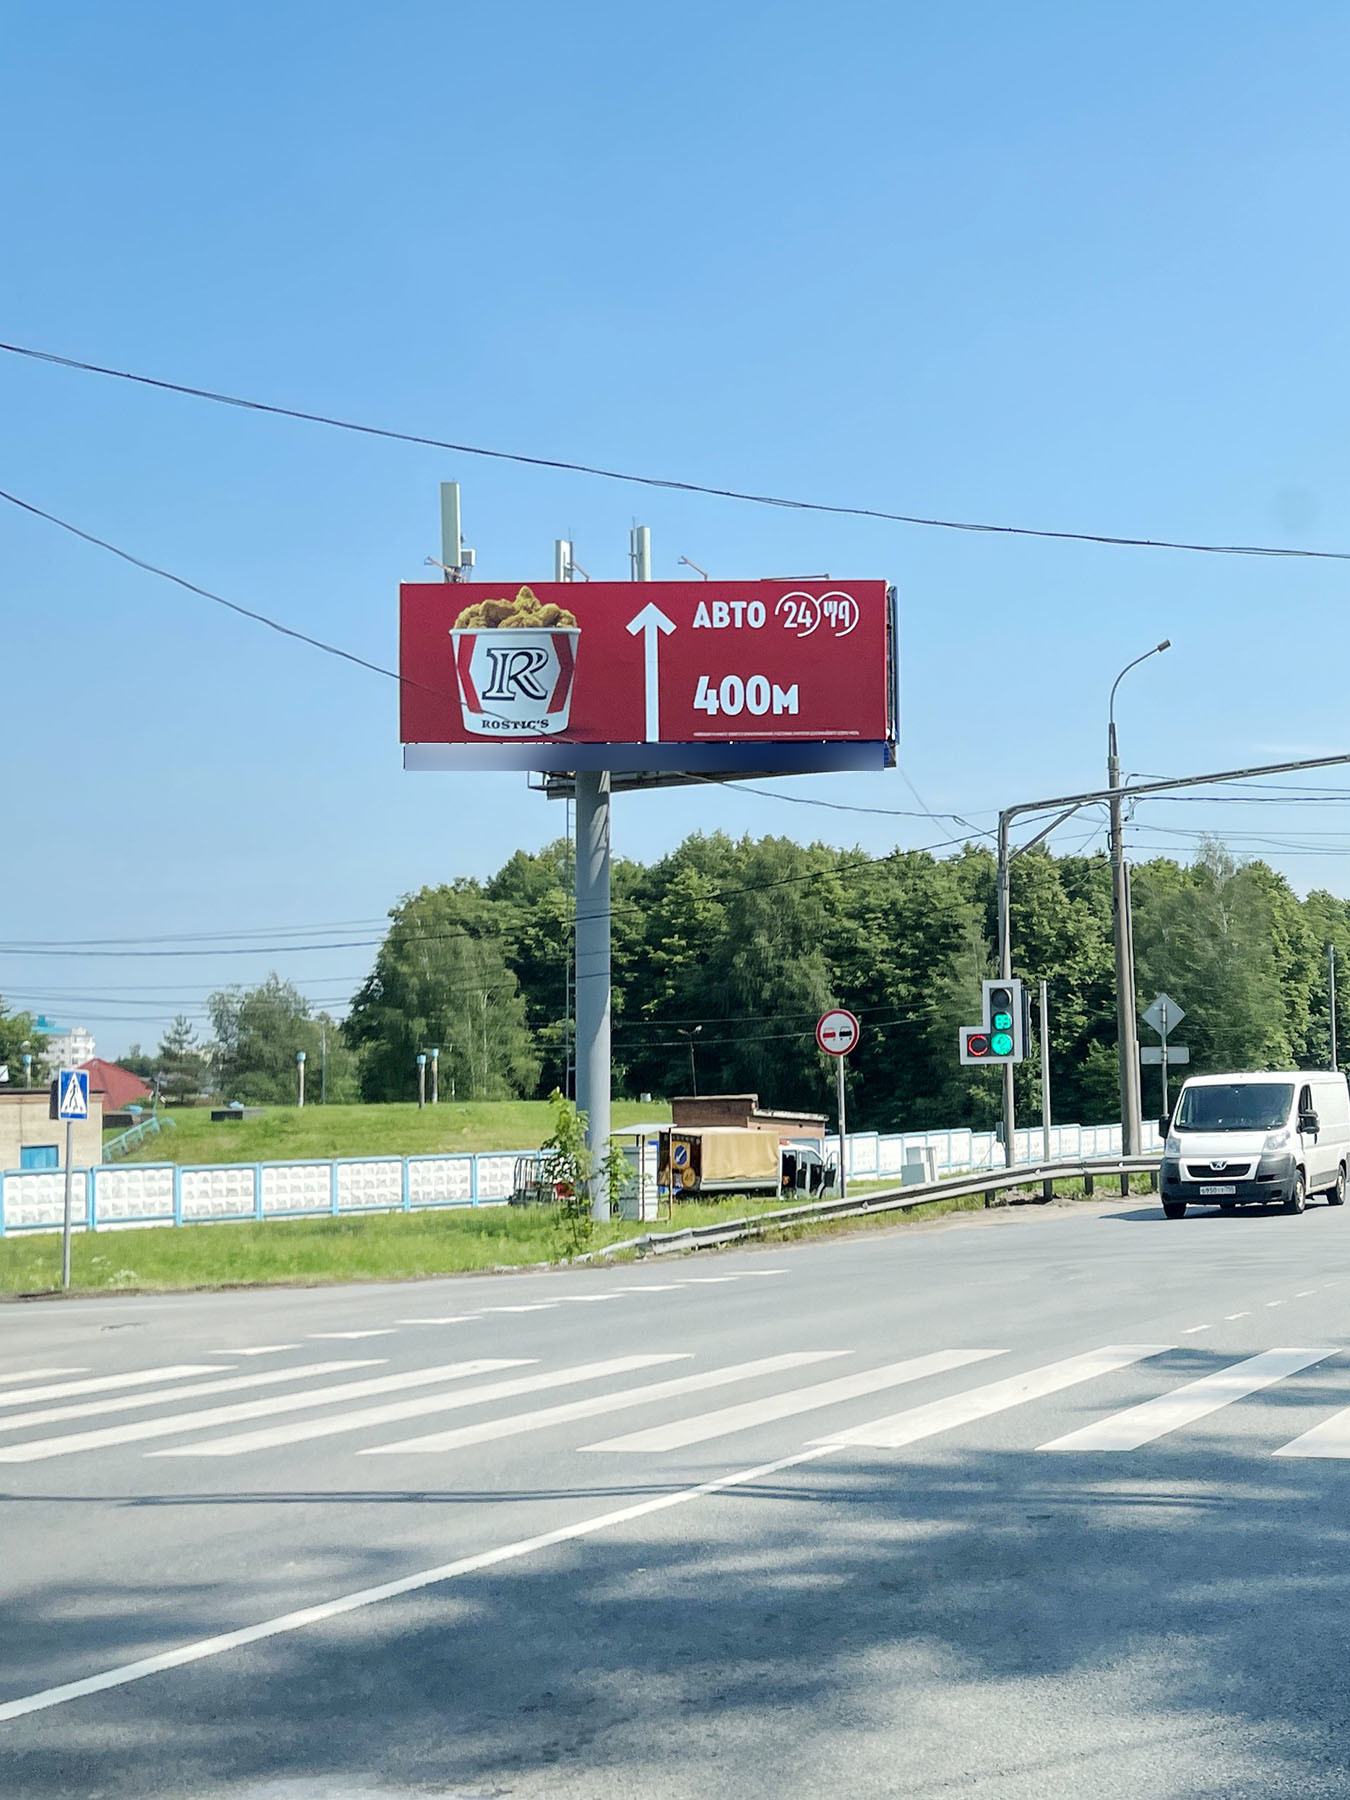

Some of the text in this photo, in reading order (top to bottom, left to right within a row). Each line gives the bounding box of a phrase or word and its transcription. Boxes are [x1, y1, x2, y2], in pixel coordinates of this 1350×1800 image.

[692, 600, 813, 629] АВТО 24
[481, 647, 549, 701] R
[481, 718, 550, 730] ROSTIC'S
